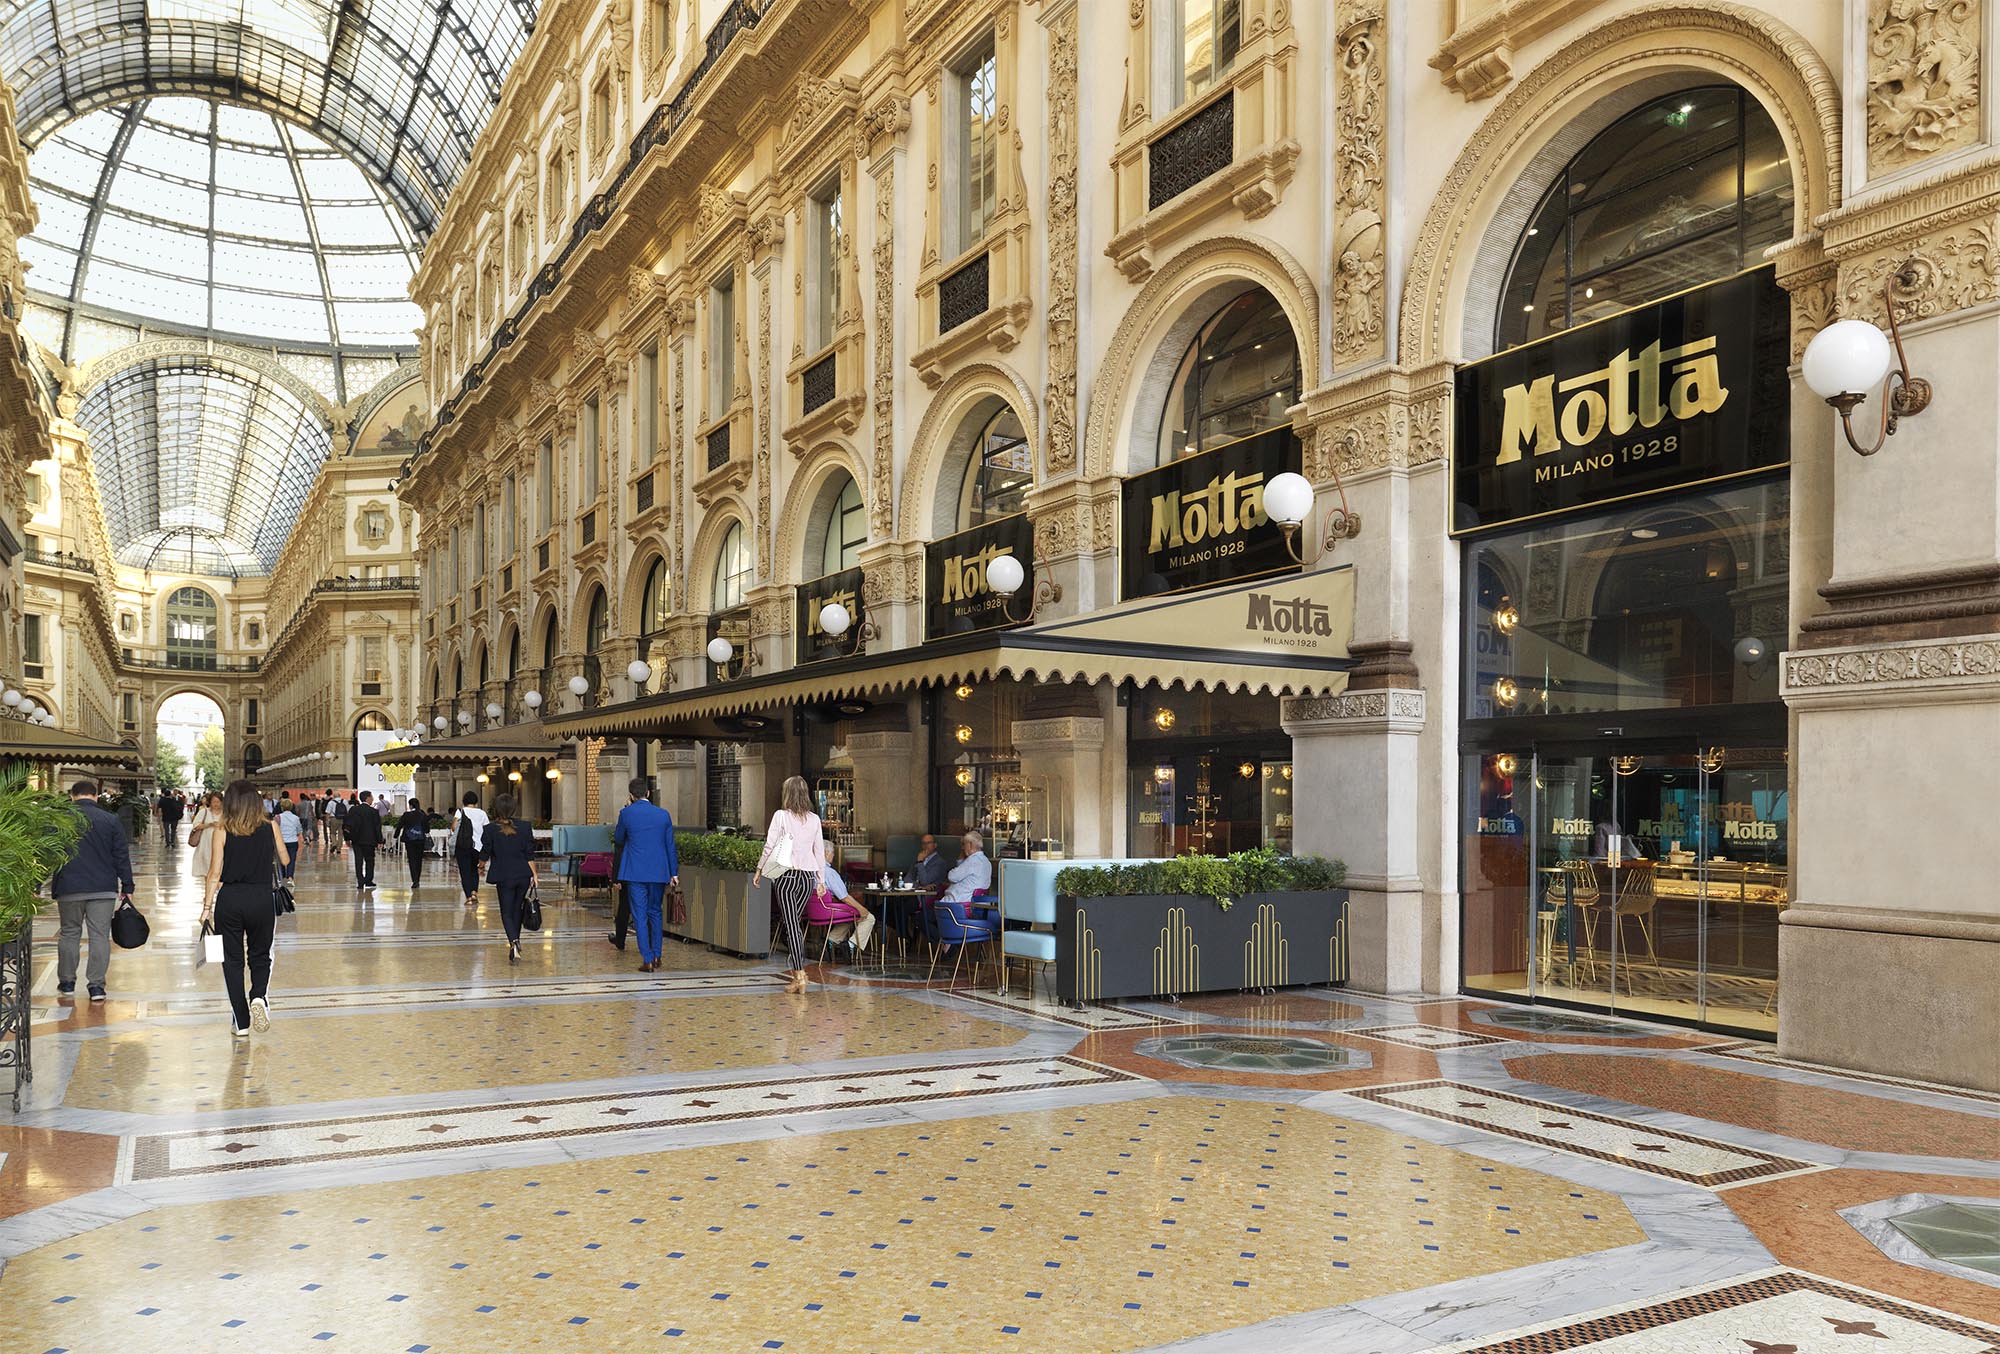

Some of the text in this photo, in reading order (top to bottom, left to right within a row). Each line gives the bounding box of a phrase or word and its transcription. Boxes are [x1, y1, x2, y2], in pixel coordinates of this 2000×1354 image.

[1496, 335, 1729, 466] Motta
[1535, 435, 1678, 483] MILANO 1928
[1169, 541, 1245, 569] MILANO 1928
[954, 603, 982, 617] MILANO
[1246, 593, 1332, 637] Motta
[1263, 636, 1318, 648] MILANO 1928
[1552, 818, 1596, 835] Motta
[1723, 820, 1778, 840] Motta
